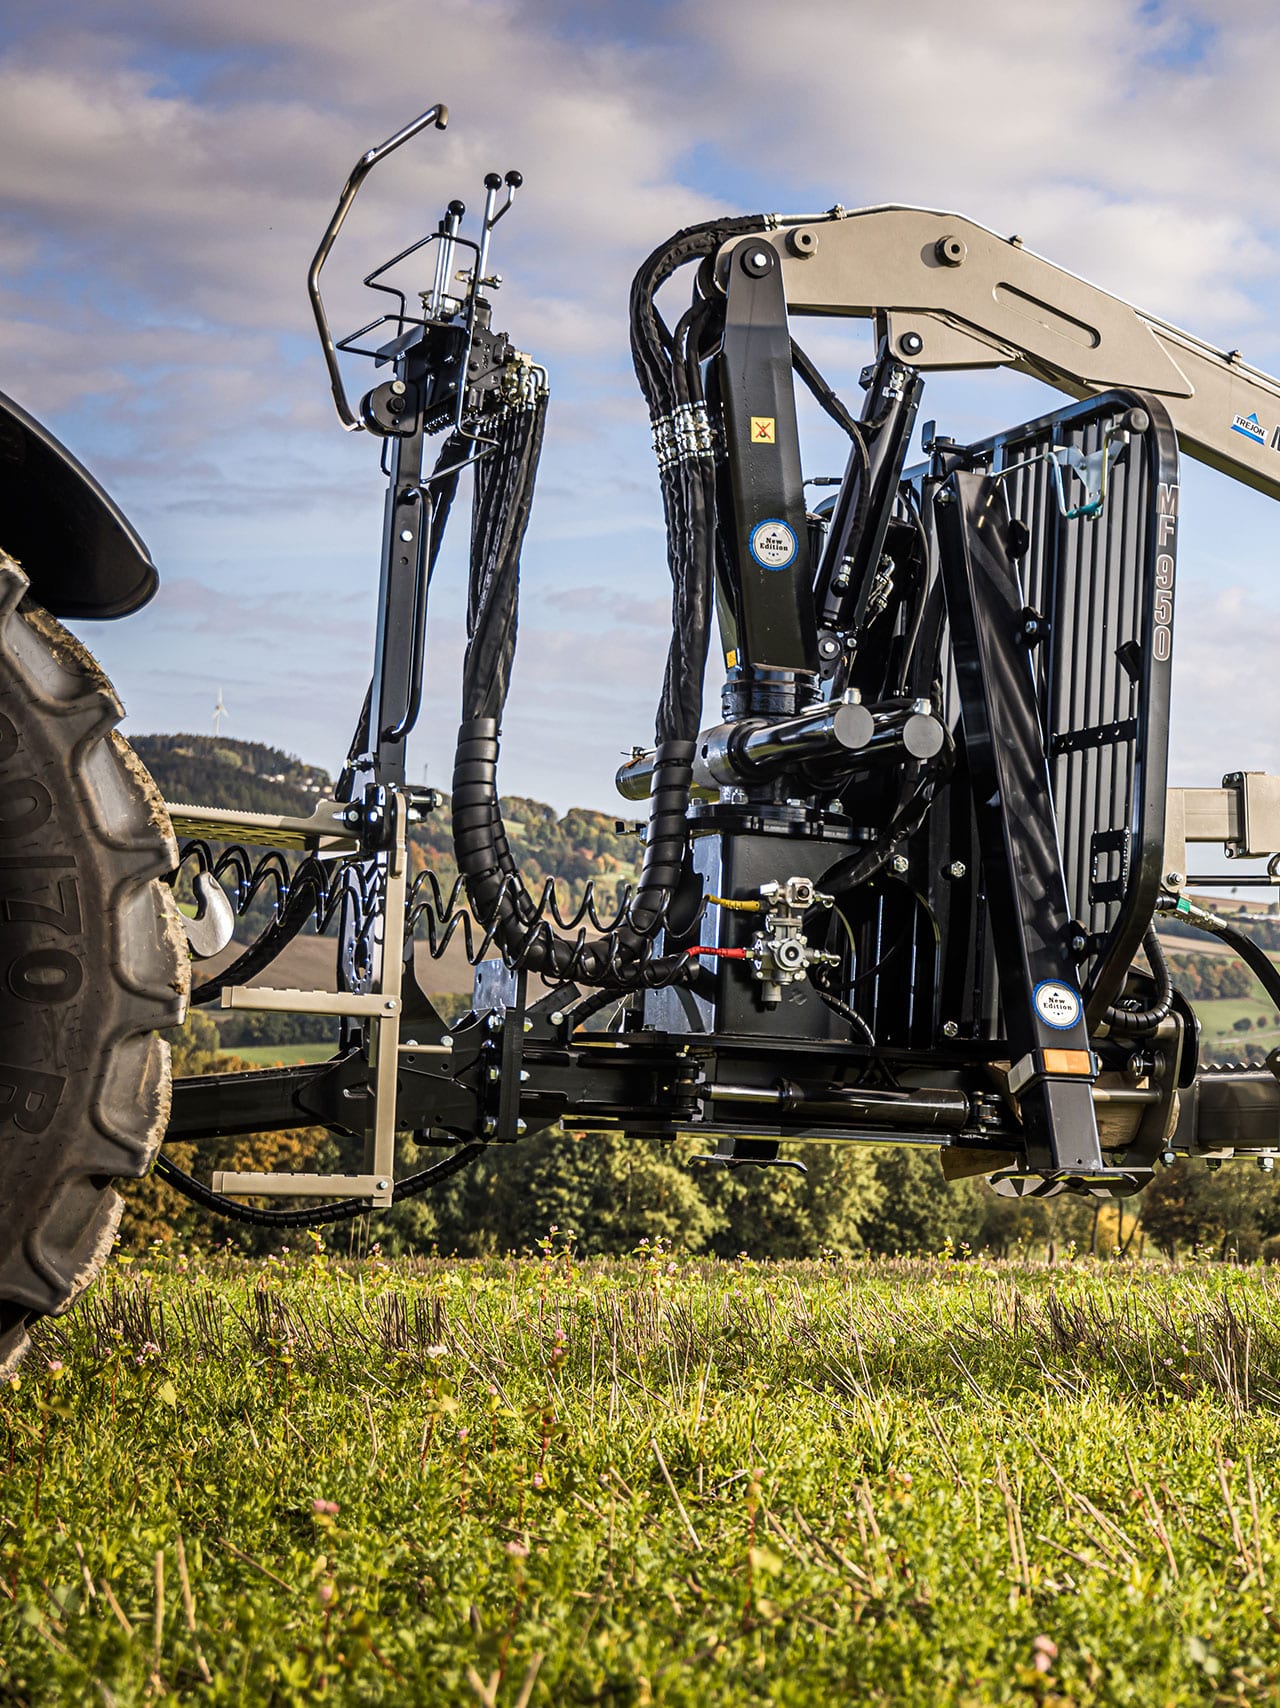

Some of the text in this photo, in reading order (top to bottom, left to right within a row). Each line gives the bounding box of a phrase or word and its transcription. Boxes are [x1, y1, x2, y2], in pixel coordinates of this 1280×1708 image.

[1235, 415, 1266, 437] TREJON
[760, 543, 788, 551] Edition
[1152, 482, 1180, 662] MF 950
